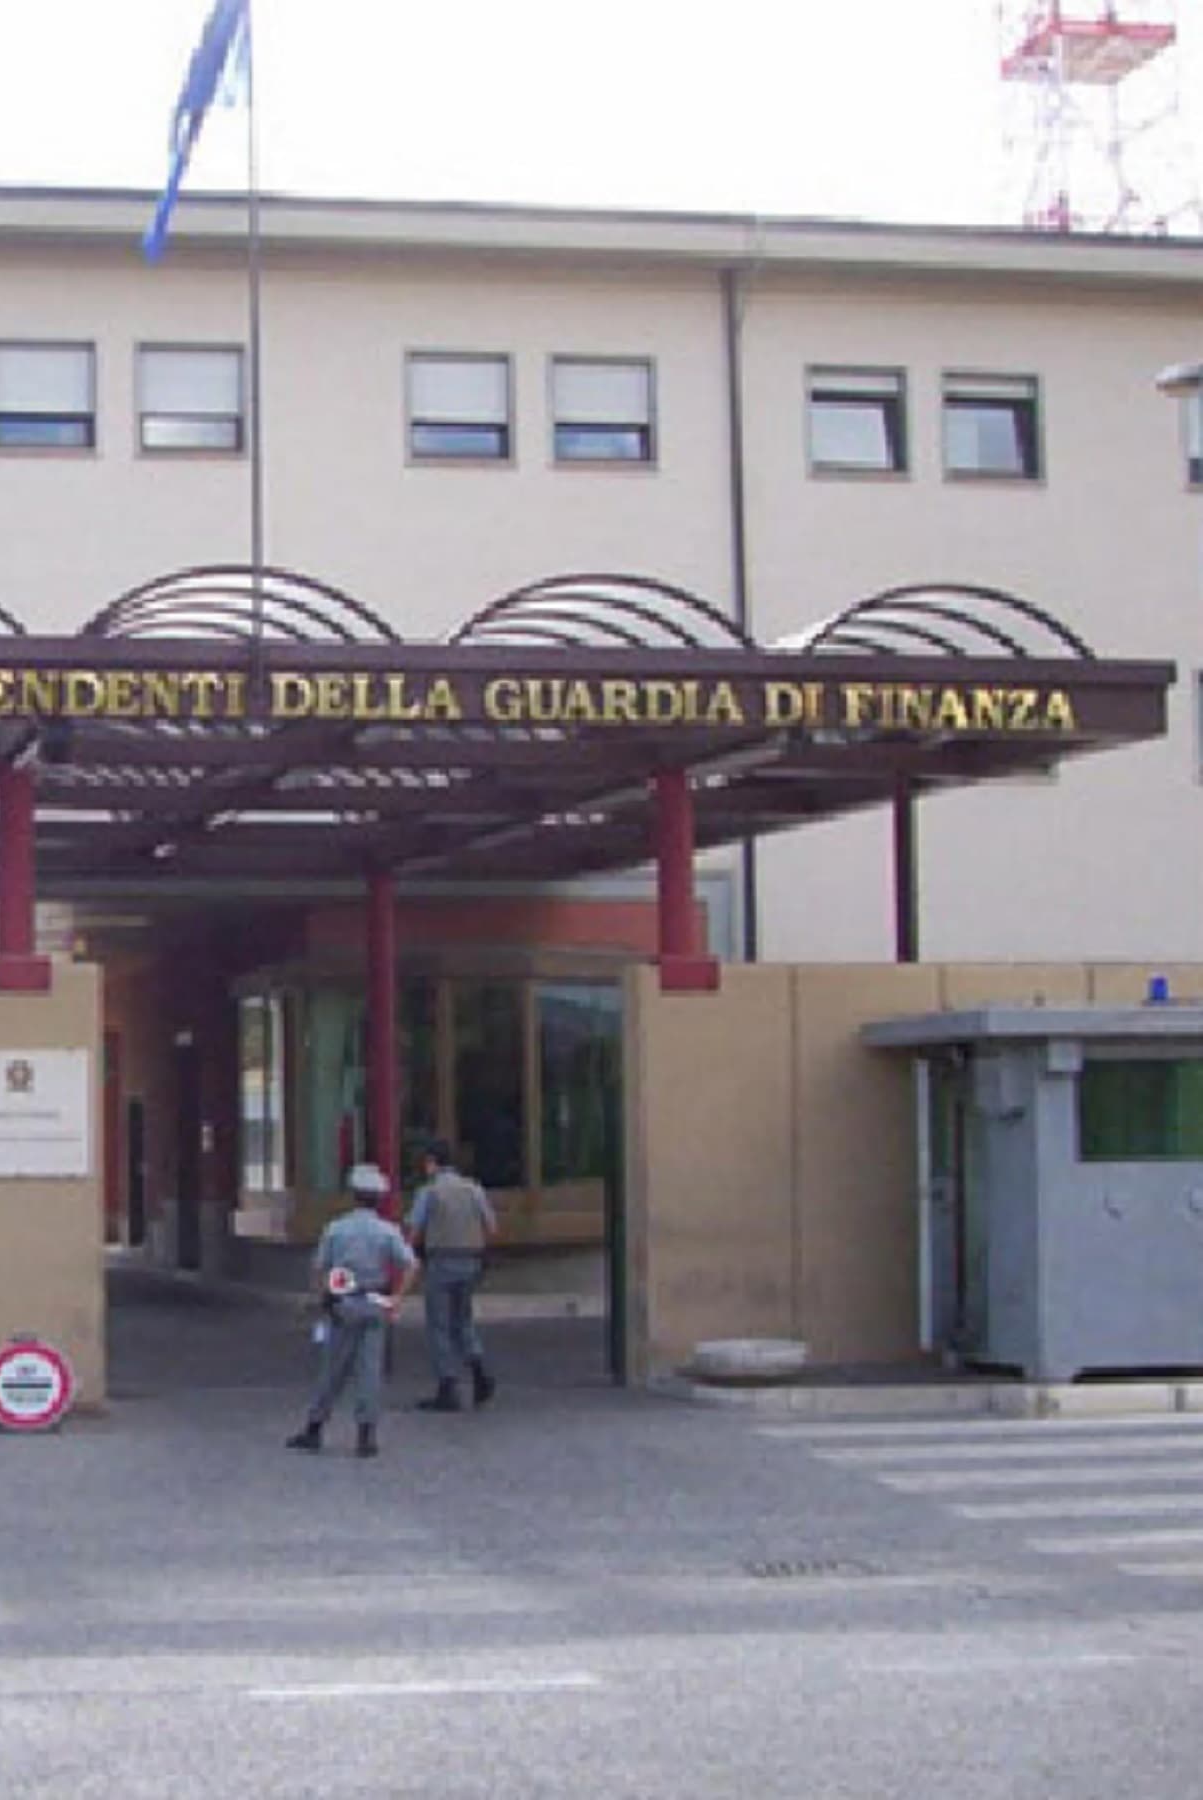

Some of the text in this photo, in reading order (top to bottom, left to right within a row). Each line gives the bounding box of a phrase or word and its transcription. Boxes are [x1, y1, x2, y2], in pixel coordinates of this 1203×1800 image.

[271, 671, 462, 719] DELLA
[484, 678, 744, 726] GUARDIA
[764, 681, 825, 728] DI
[841, 684, 1075, 731] FINANZA
